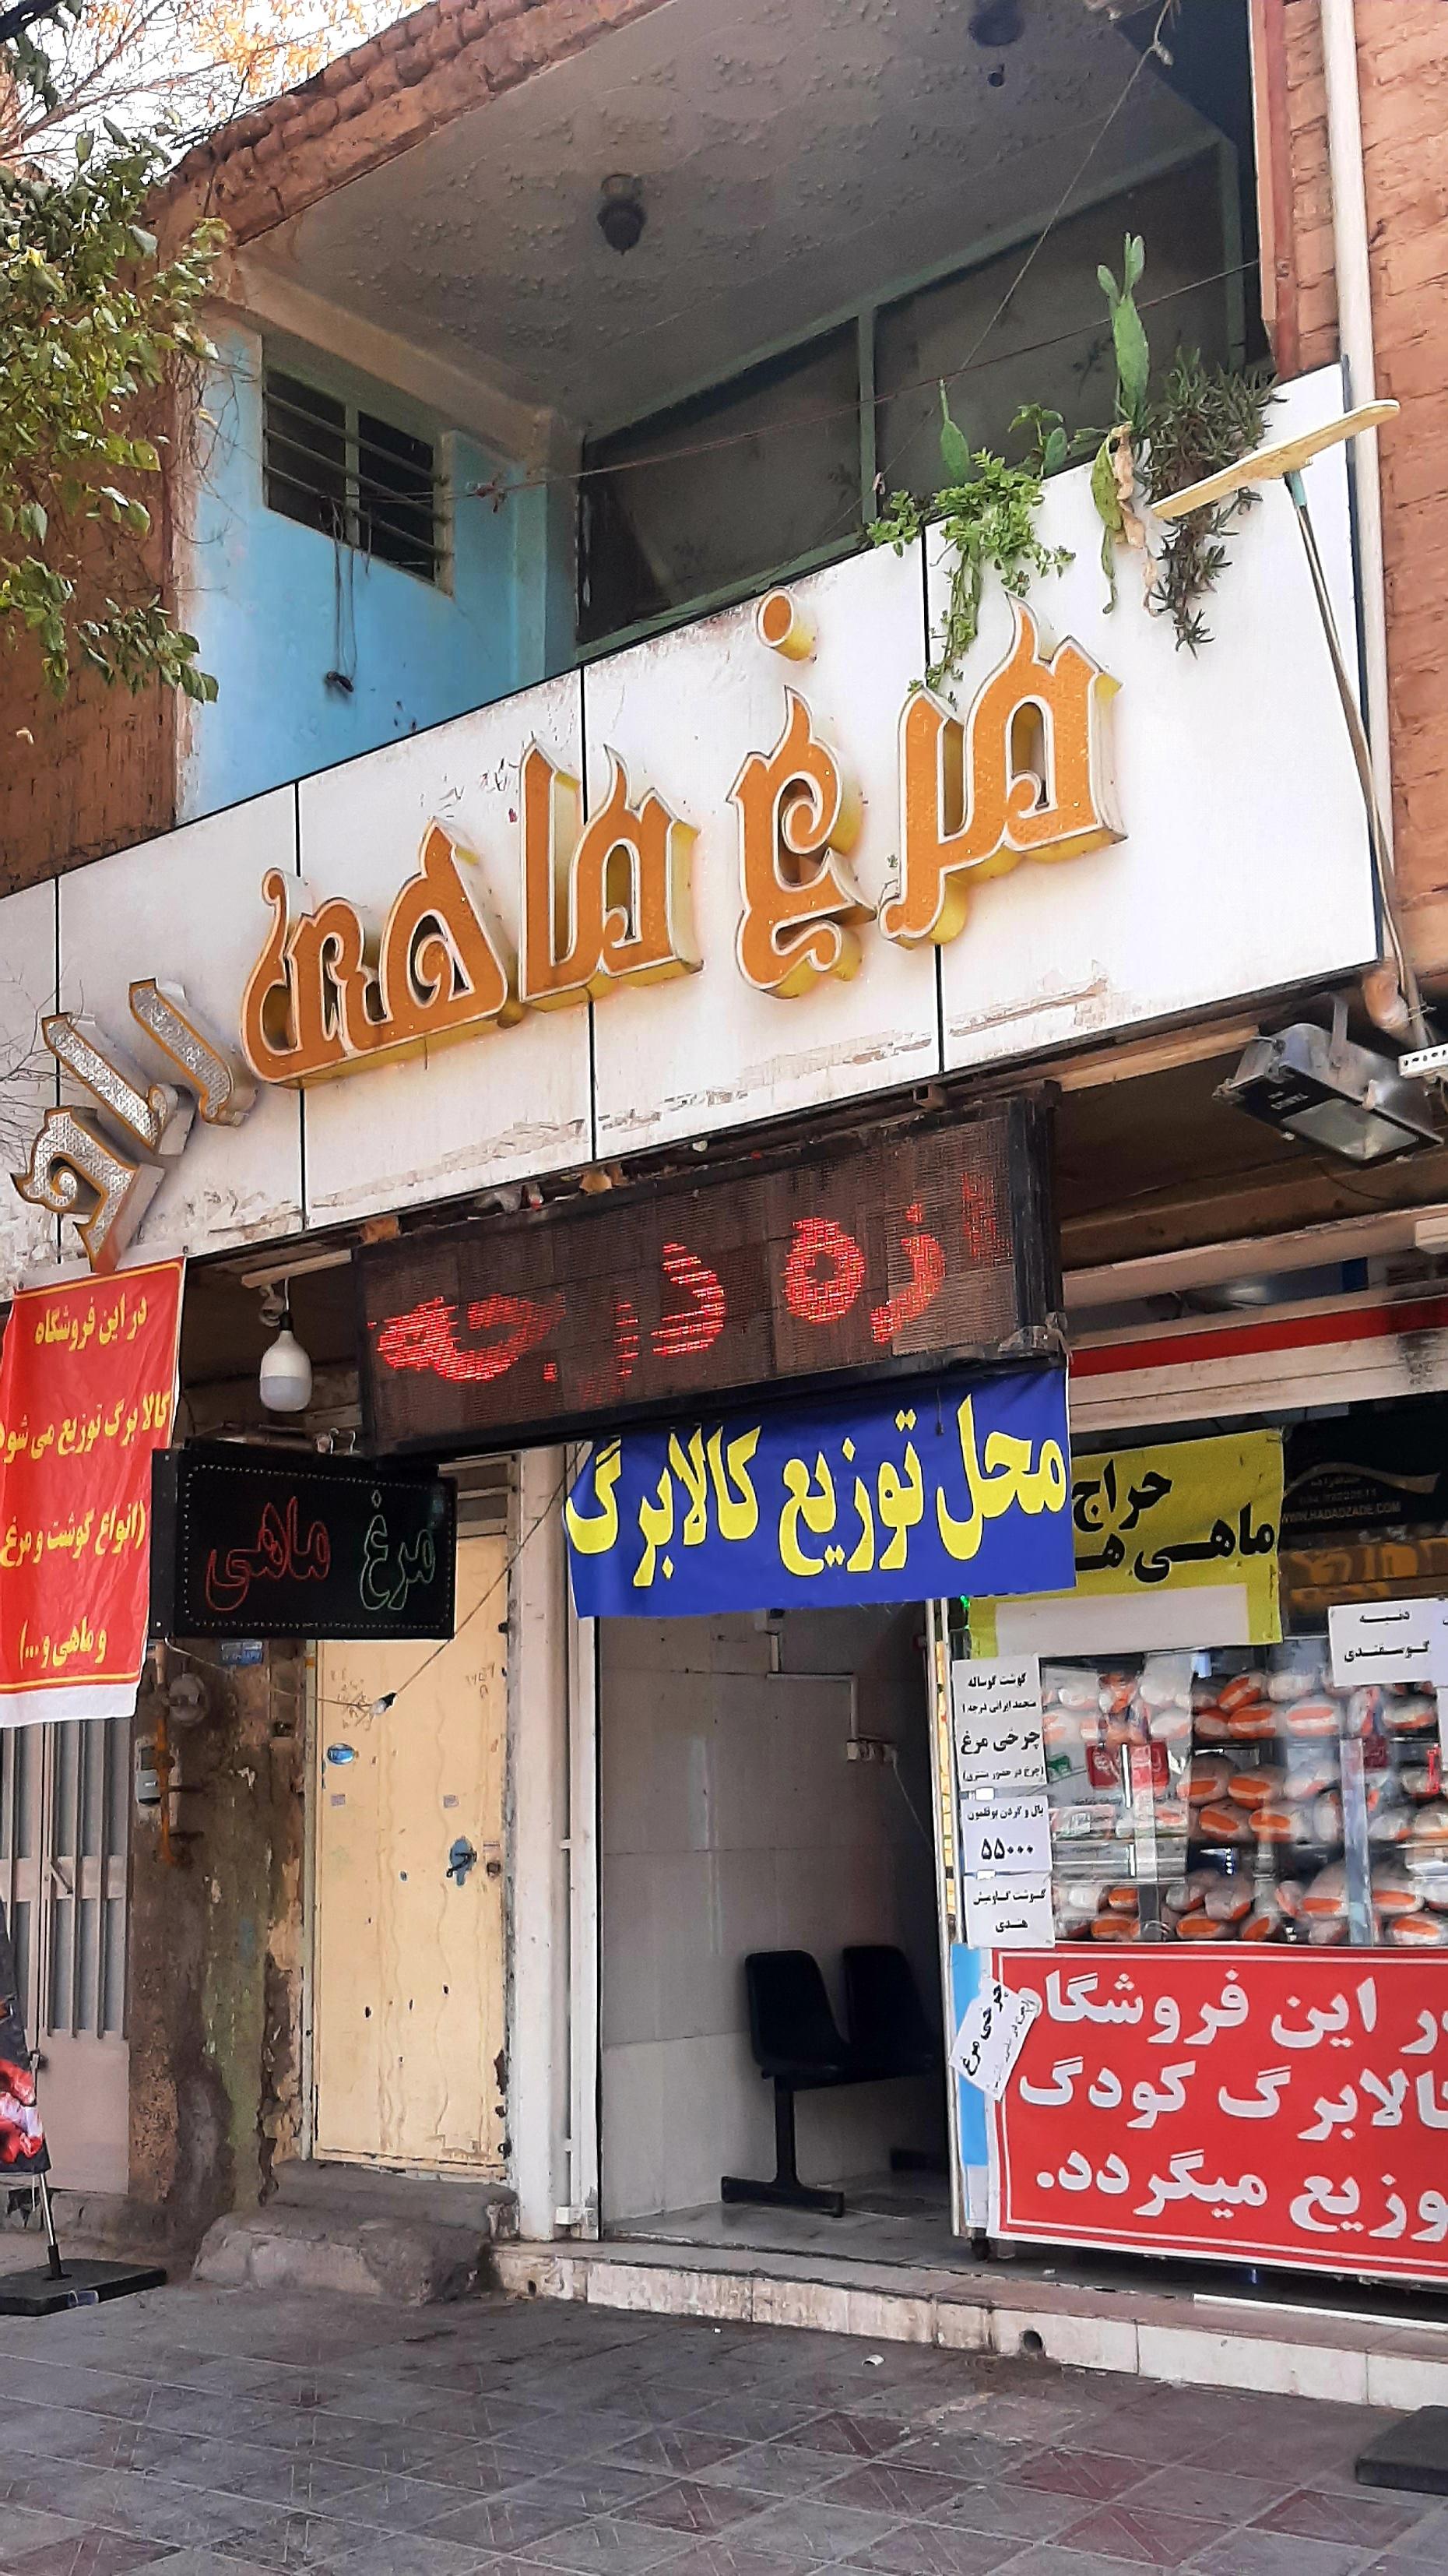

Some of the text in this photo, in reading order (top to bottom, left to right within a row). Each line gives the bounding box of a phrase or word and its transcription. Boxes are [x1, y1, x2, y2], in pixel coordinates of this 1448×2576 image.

[240, 588, 1129, 1089] مرغ ماهی
[35, 1292, 147, 1352] در این فروشگاه
[31, 1423, 54, 1459] می
[58, 1404, 102, 1455] توزیع
[565, 1394, 1067, 1589] محل توزیع کالابرگ
[1072, 1459, 1172, 1533] حراج
[0, 1516, 32, 1568] مرغ
[33, 1531, 43, 1564] و
[47, 1511, 96, 1559] گوشت
[206, 1489, 436, 1610] مرغ ماهی
[1133, 1501, 1274, 1583] ماهی
[52, 1616, 94, 1667] ماهی
[94, 1629, 107, 1663] و
[968, 1672, 1027, 1690] گوشت گوساله
[961, 1730, 989, 1754] مرغ
[1031, 1804, 1044, 1818] بال
[981, 1838, 1034, 1860] ۵۵۰۰۰
[1012, 1888, 1047, 1904] گوشت
[1271, 1976, 1378, 2050] این
